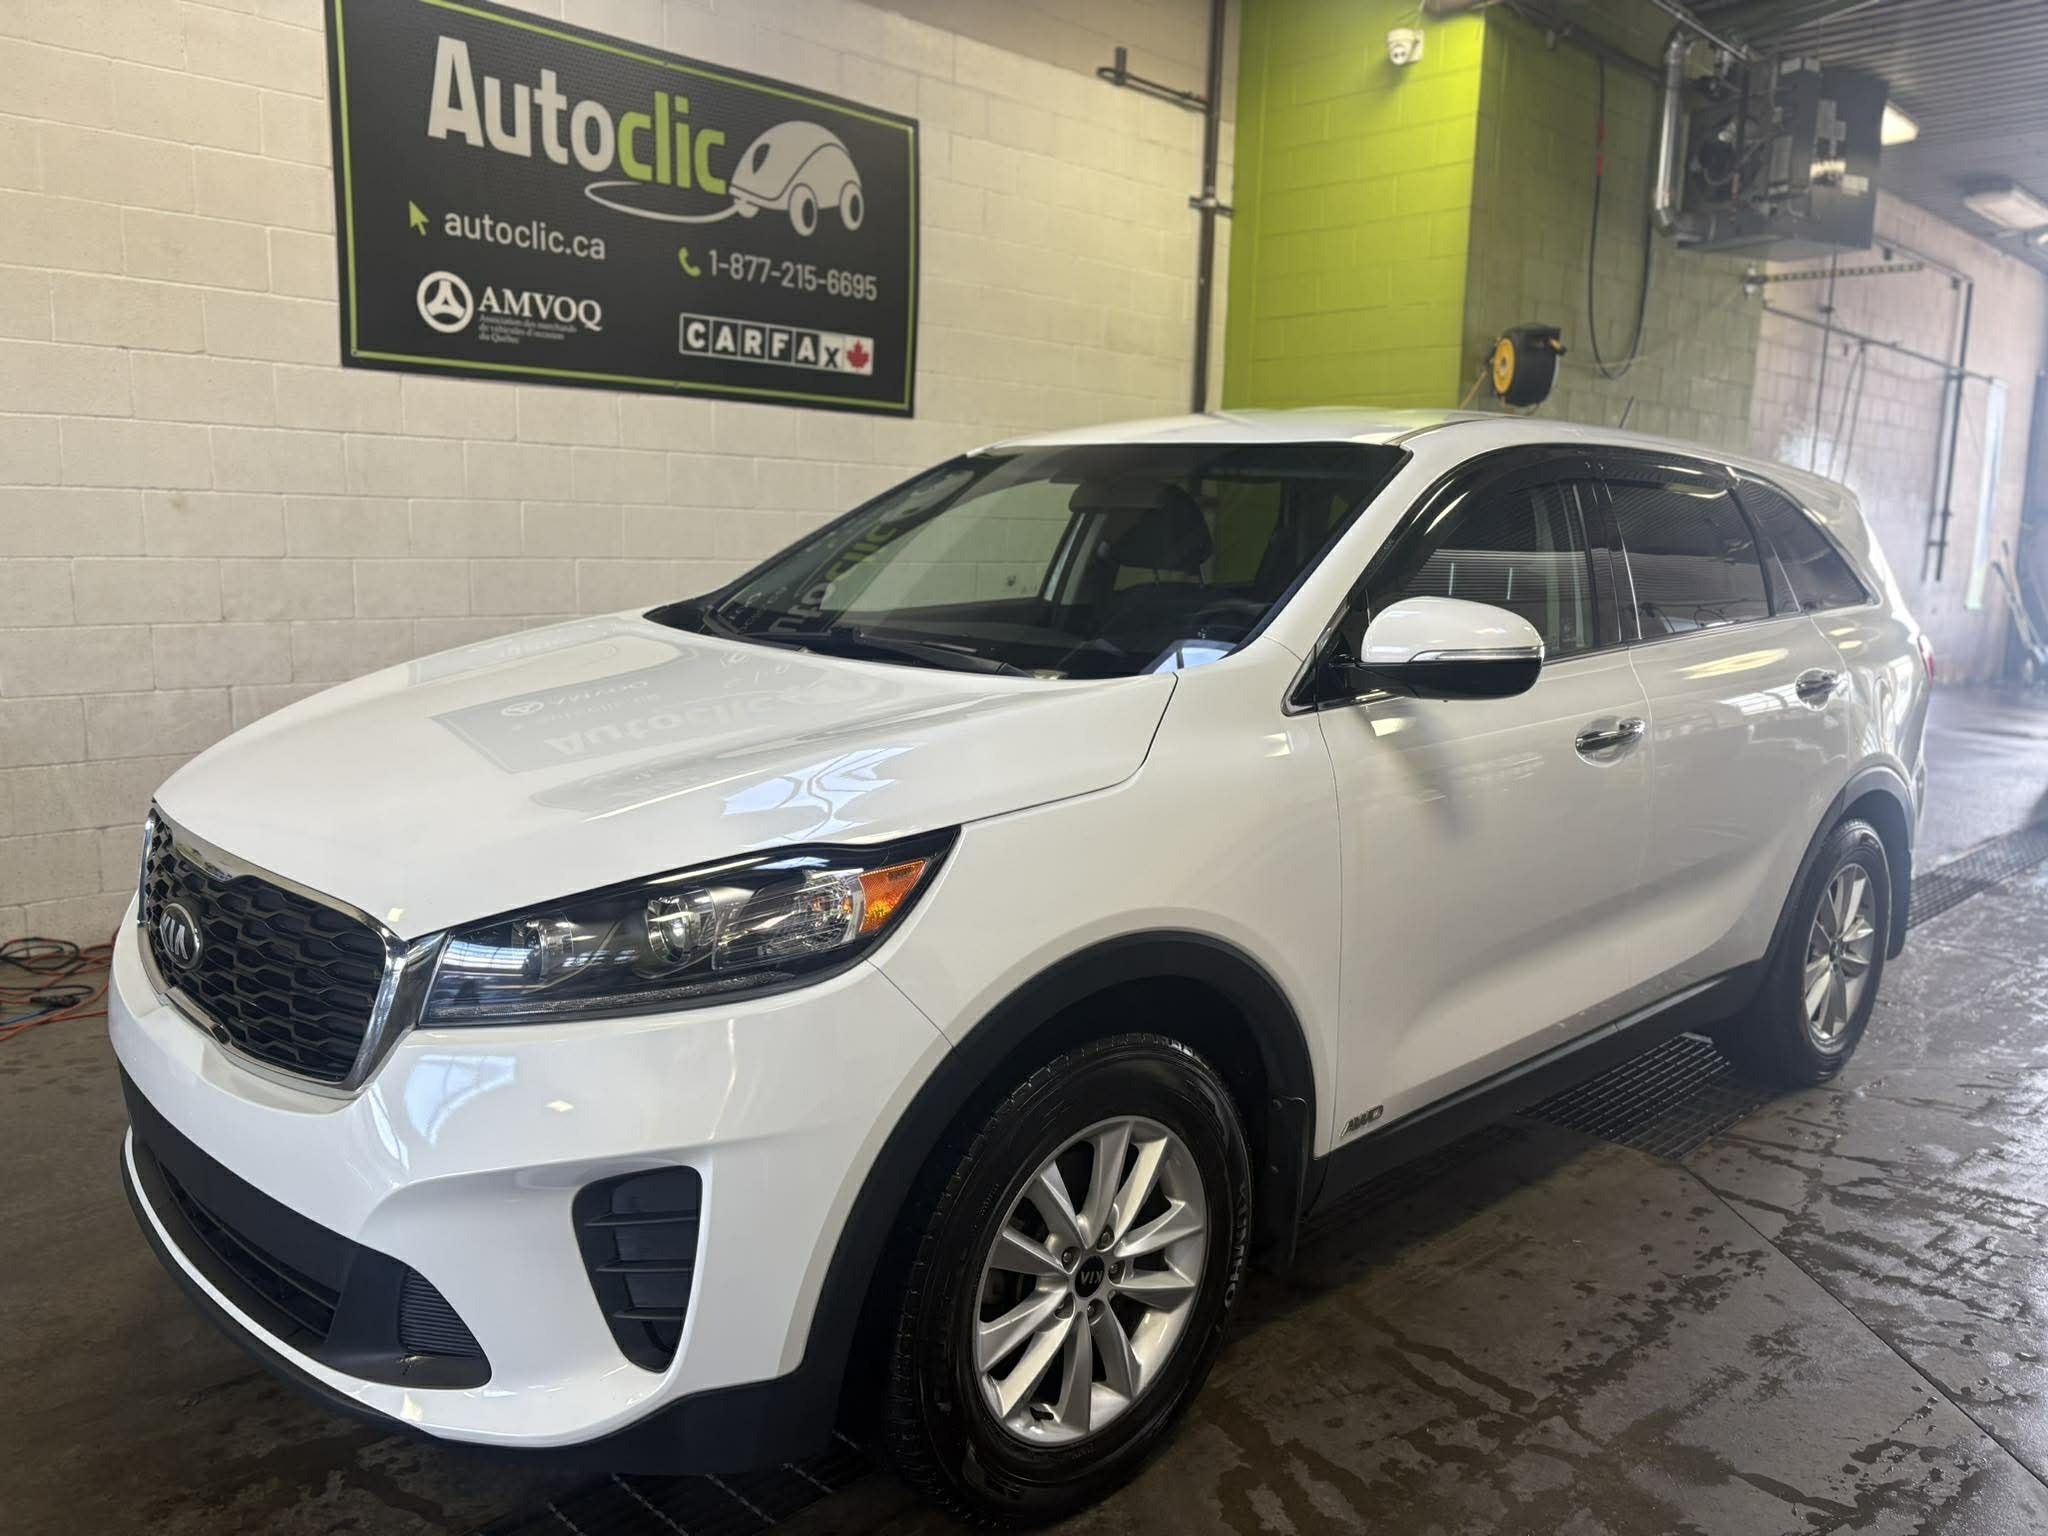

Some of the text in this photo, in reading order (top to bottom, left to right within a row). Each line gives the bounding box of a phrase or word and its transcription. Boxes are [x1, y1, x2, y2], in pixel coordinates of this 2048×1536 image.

[428, 35, 727, 195] Autoclic
[444, 202, 606, 260] autoclic.ca
[708, 249, 878, 301] 1-877-215-6695
[478, 286, 603, 332] AMVOQ
[686, 321, 838, 369] CARFAX
